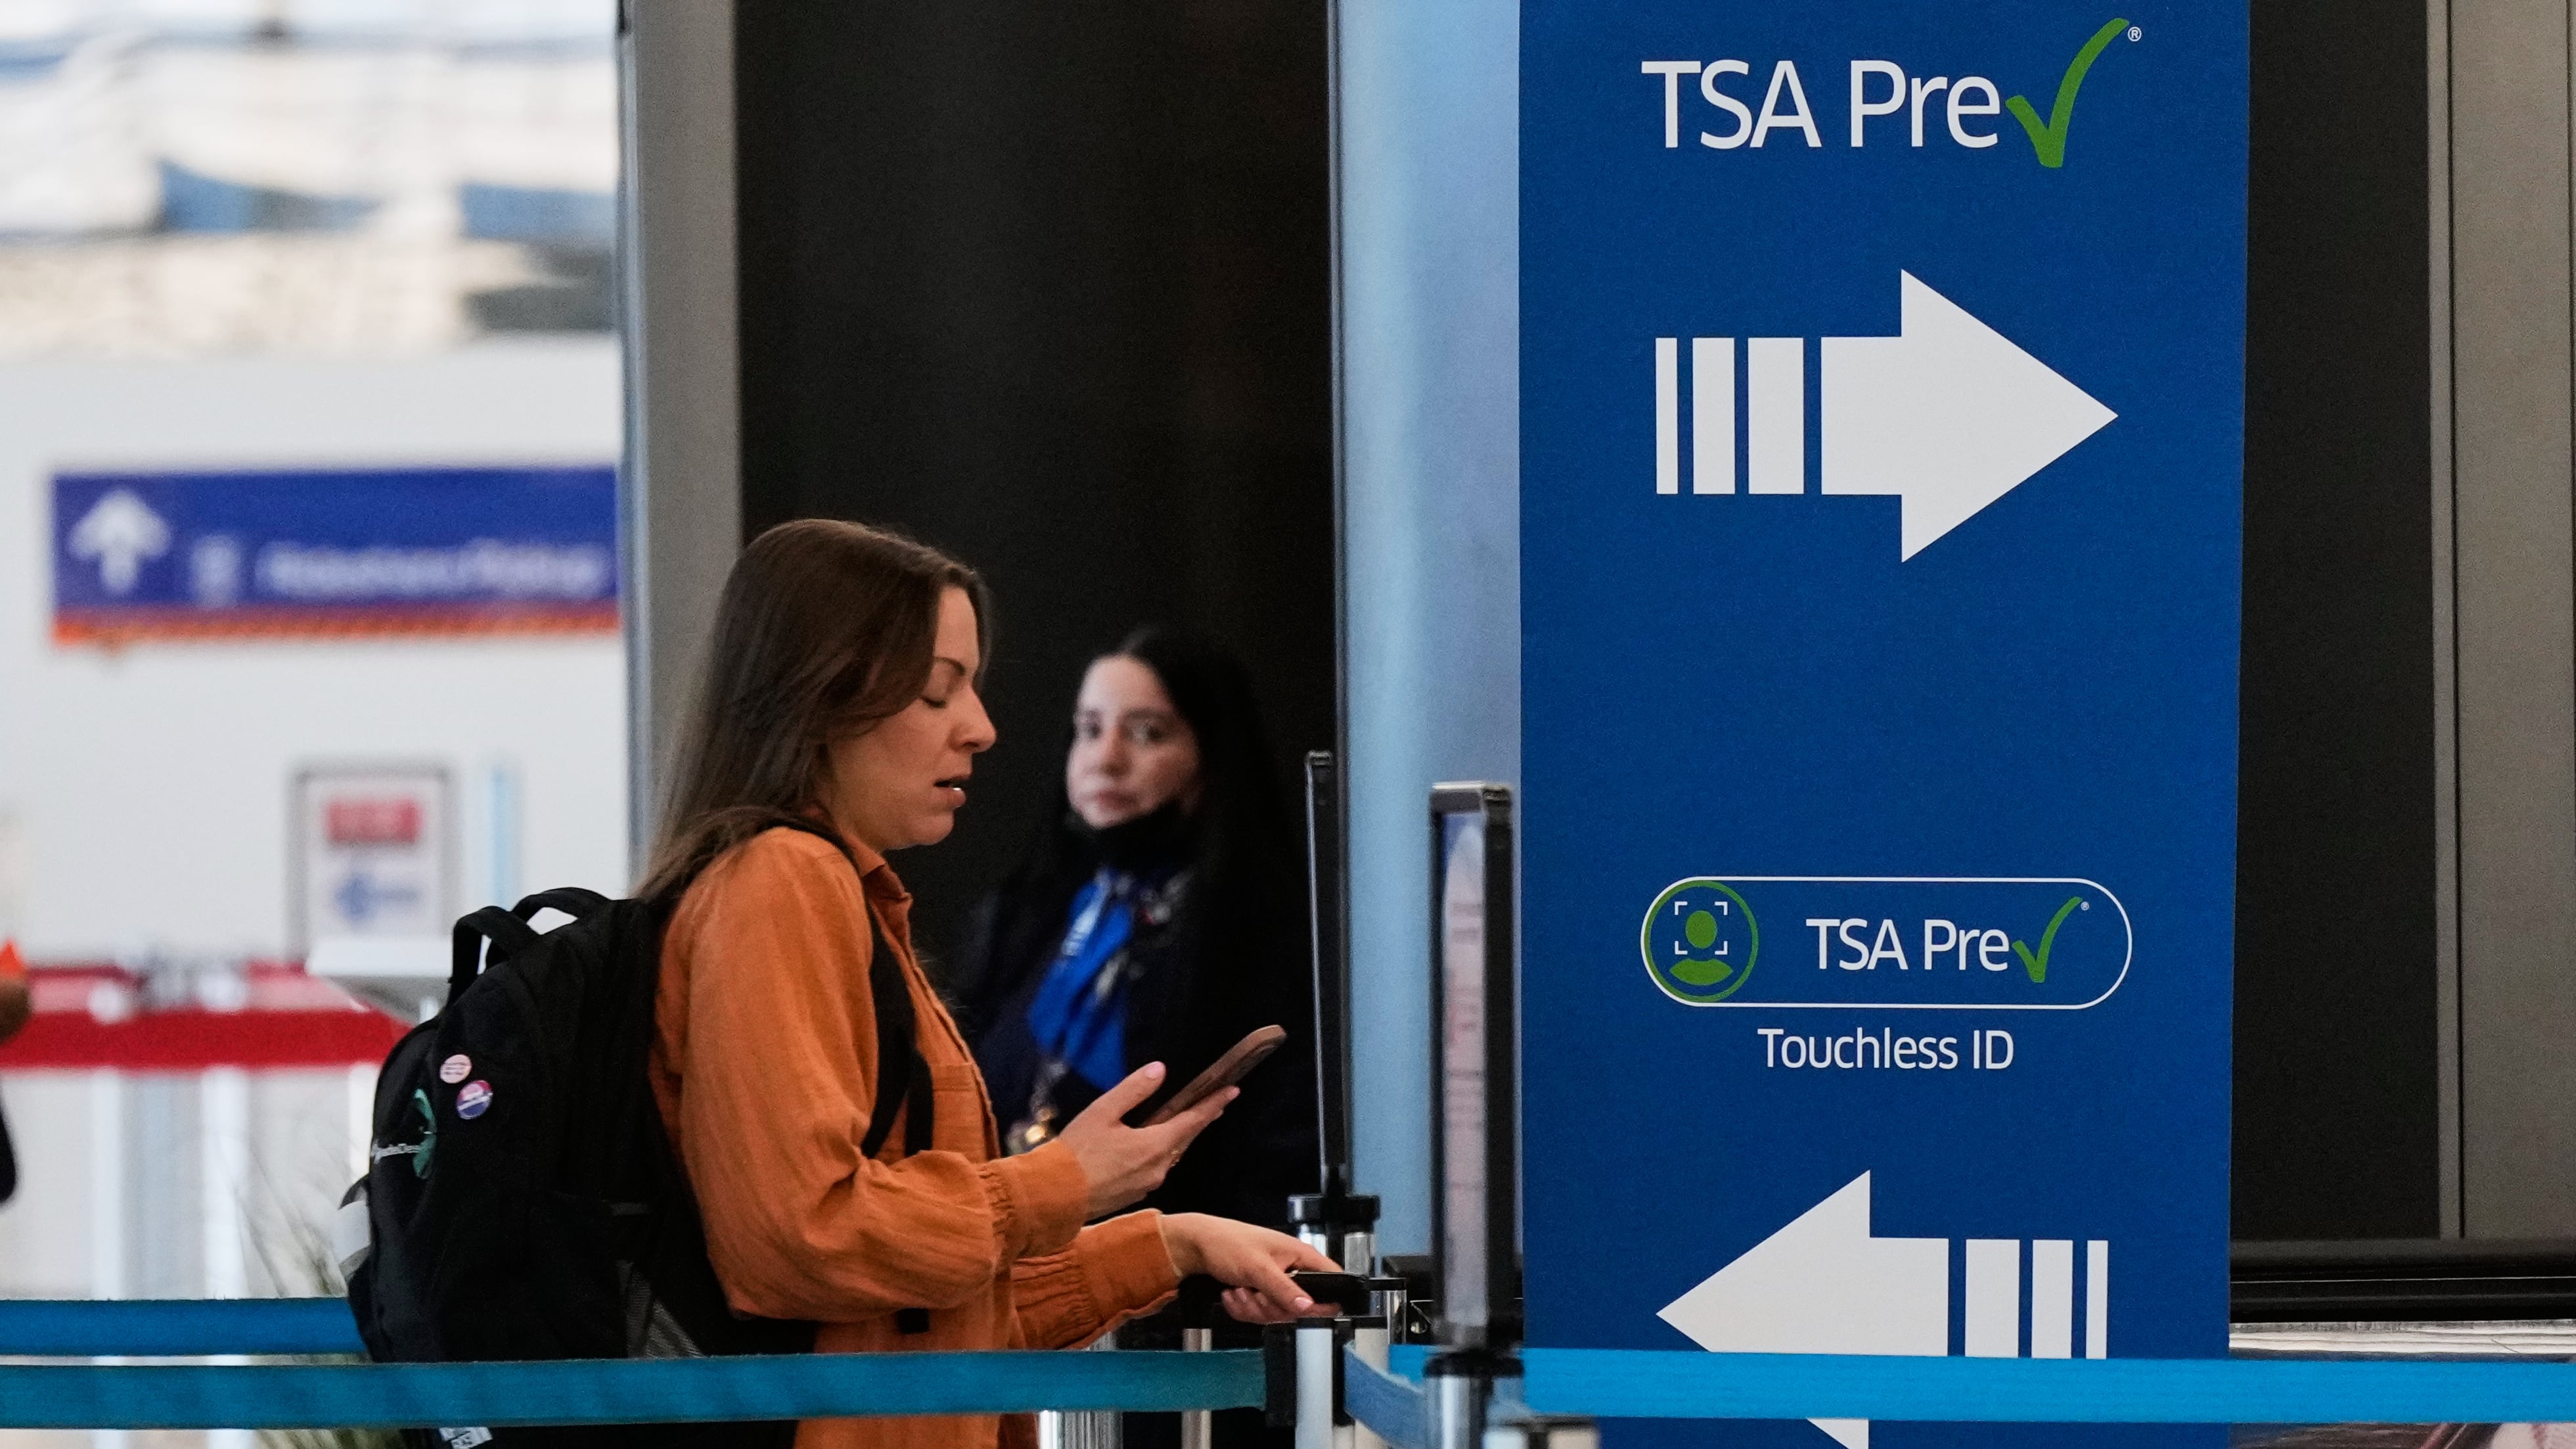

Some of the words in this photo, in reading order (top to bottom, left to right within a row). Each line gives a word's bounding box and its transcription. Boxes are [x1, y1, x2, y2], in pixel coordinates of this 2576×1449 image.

[1642, 60, 1822, 149] TSA
[1806, 918, 1909, 970] TSA
[1757, 1027, 1958, 1069] Touchless
[1974, 1030, 2014, 1069] ID
